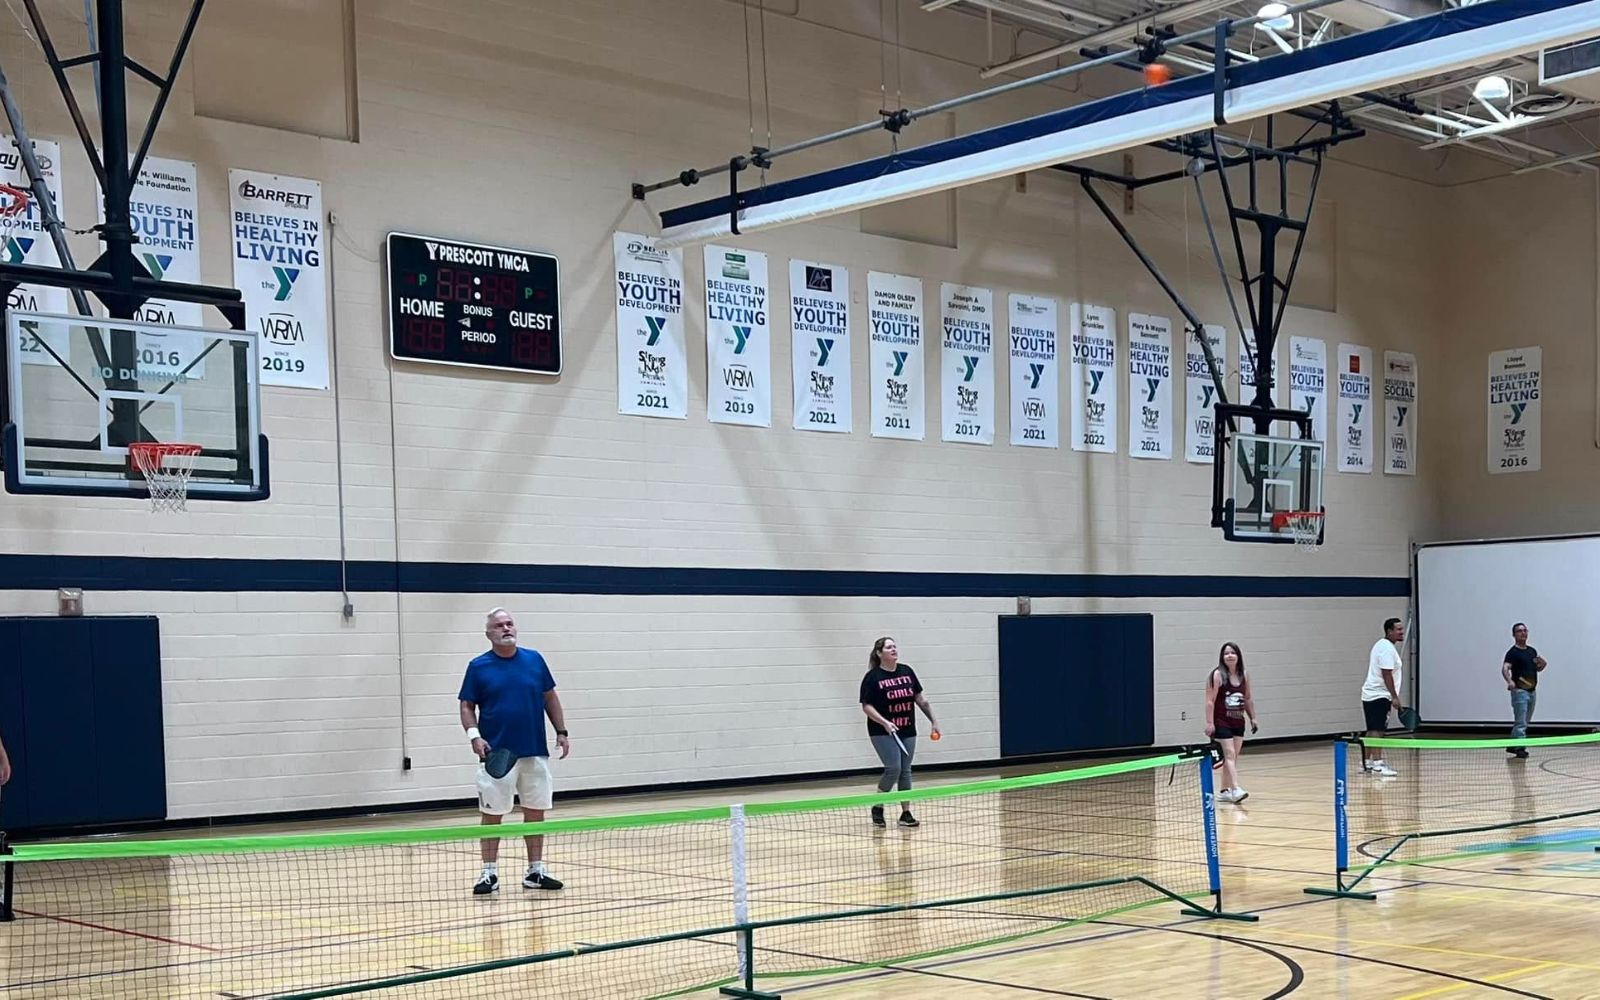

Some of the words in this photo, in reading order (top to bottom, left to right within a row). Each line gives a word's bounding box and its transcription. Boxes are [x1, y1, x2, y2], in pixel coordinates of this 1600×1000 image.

[152, 172, 186, 183] Williams
[146, 180, 190, 192] Foundation
[243, 184, 312, 206] BARRETT
[130, 202, 172, 217] IEVES
[176, 208, 193, 219] IN
[130, 214, 194, 241] OUTH
[235, 211, 299, 229] BELIEVES
[303, 220, 319, 232] IN
[235, 224, 317, 248] HEALTHY
[236, 241, 320, 268] LIVING
[440, 244, 494, 268] PRESCOTT
[497, 252, 530, 273] YMCA
[418, 274, 427, 286] P
[618, 271, 666, 286] BELIEVES
[668, 278, 680, 289] IN
[524, 287, 533, 299] P
[618, 281, 681, 306] YOUTH
[707, 279, 752, 295] BELIEVES
[754, 286, 765, 296] IN
[708, 290, 765, 309] HEALTHY
[874, 290, 896, 299] DAMON
[897, 294, 915, 302] OLSEN
[878, 299, 890, 307] AND
[400, 297, 445, 319] HOME
[463, 304, 493, 317] BONUS
[619, 298, 681, 314] DEVELOPMENT
[793, 296, 834, 310] BELIEVES
[836, 301, 847, 311] IN
[509, 310, 553, 331] GUEST
[708, 304, 766, 326] LIVING
[794, 306, 847, 327] YOUTH
[872, 310, 908, 323] BELIEVES
[910, 314, 920, 324] IN
[794, 322, 847, 335] DEVELOPMENT
[872, 319, 919, 339] YOUTH
[943, 316, 979, 330] BELIEVES
[981, 321, 991, 331] IN
[461, 330, 497, 344] PERIOD
[943, 326, 991, 346] YOUTH
[1011, 326, 1045, 338] BELIEVES
[1046, 330, 1055, 339] IN
[872, 334, 919, 346] DEVELOPMENT
[943, 340, 991, 354] DEVELOPMENT
[1011, 335, 1055, 353] YOUTH
[1072, 335, 1104, 346] BELIEVES
[1106, 339, 1114, 347] IN
[1072, 343, 1114, 361] YOUTH
[1130, 341, 1160, 353] BELIEVES
[1161, 345, 1169, 354] IN
[1011, 349, 1055, 361] DEVELOPMENT
[1130, 350, 1169, 364] HEALTHY
[262, 357, 305, 373] 2019
[1072, 357, 1114, 368] DEVELOPMENT
[1130, 361, 1169, 378] LIVING
[1291, 365, 1316, 375] BELIEVES
[1490, 372, 1528, 383] BELIEVES
[1530, 371, 1540, 379] IN
[1291, 373, 1324, 387] YOUTH
[1491, 379, 1539, 393] HEALTHY
[1339, 381, 1370, 394] YOUTH
[1384, 385, 1416, 398] SOCIAL
[637, 394, 669, 409] 2021
[1490, 389, 1539, 404] LIVING
[725, 401, 754, 414] 2019
[809, 410, 837, 424] 2021
[885, 416, 911, 429] 2011
[955, 423, 981, 436] 2017
[1023, 429, 1046, 440] 2021
[1083, 434, 1105, 445] 2022
[1141, 440, 1161, 452] 2021
[1196, 445, 1215, 457] 2021
[1346, 456, 1364, 466] 2014
[1501, 457, 1528, 468] 2016
[878, 676, 912, 690] PRETTY
[886, 687, 914, 700] GIRLS
